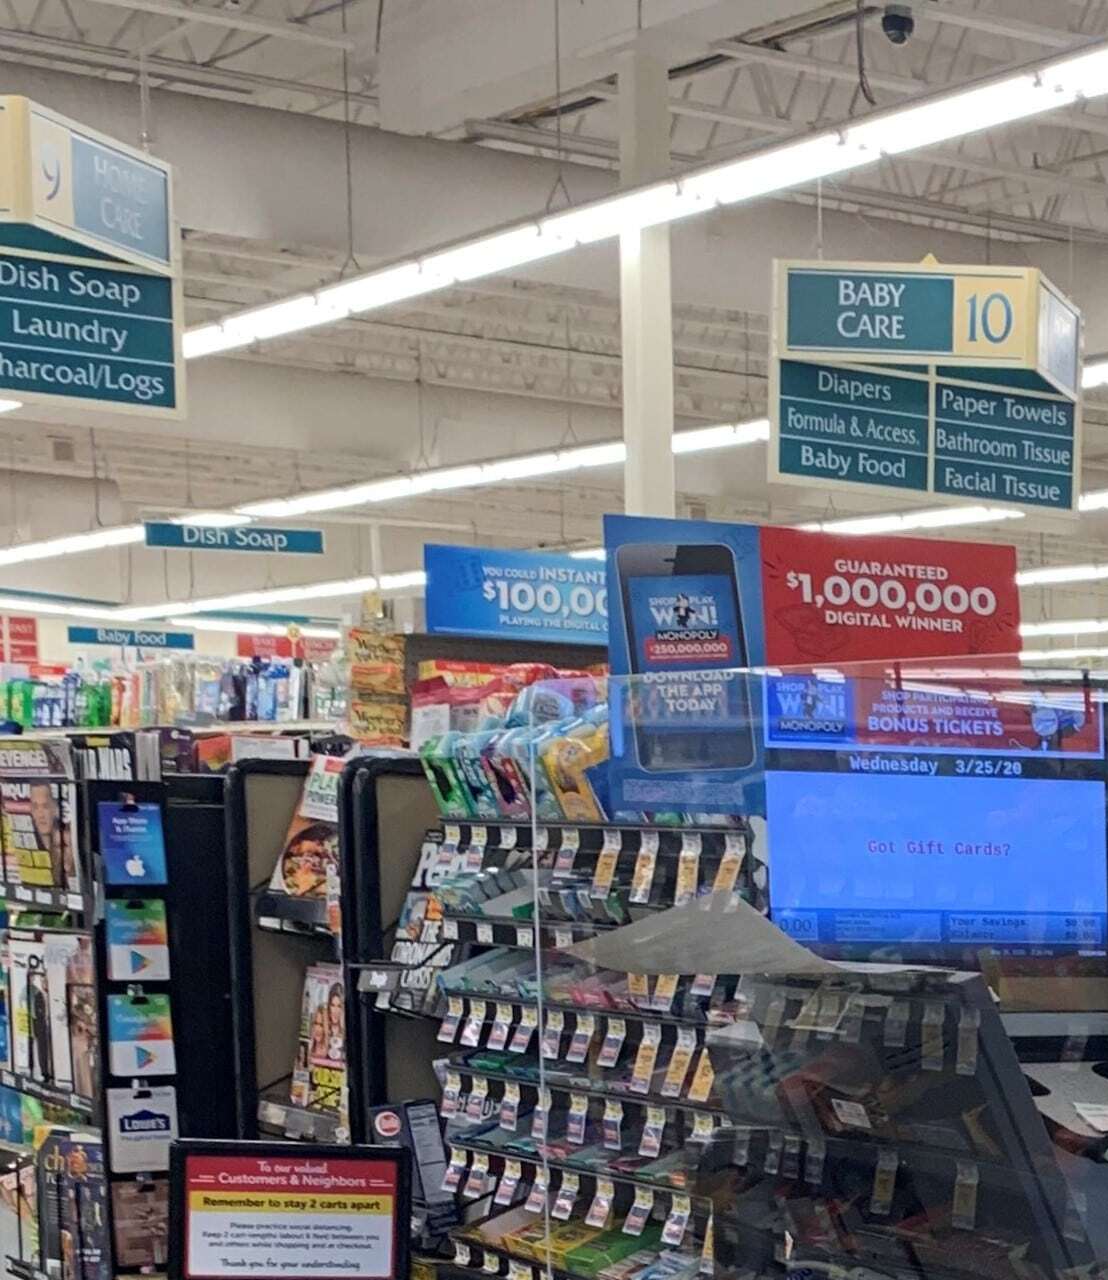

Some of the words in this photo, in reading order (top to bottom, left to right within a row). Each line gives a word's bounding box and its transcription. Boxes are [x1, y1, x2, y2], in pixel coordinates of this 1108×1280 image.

[0, 262, 59, 293] Dish
[68, 271, 141, 308] Soap
[838, 279, 906, 308] BABY
[836, 312, 906, 340] CARE
[966, 292, 1013, 344] 10
[12, 309, 128, 352] Laundry
[0, 354, 165, 401] harcoal/Logs
[818, 371, 892, 402] Diapers
[941, 389, 997, 418] Paper
[1003, 398, 1068, 427] Towels
[787, 407, 846, 437] Formula
[849, 417, 863, 438] &
[866, 420, 920, 446] Access.
[936, 429, 1017, 459] Bathroom
[1022, 441, 1071, 466] Tissue
[801, 445, 852, 475] Baby
[858, 453, 906, 478] Food
[944, 467, 996, 492] Facial
[1003, 475, 1061, 501] Tissue
[183, 525, 229, 546] Dish
[235, 526, 288, 552] Soap
[482, 566, 503, 577] YOU
[505, 569, 538, 580] COULD
[539, 566, 607, 583] INSTANT
[834, 559, 948, 581] GUARANTEED
[786, 571, 997, 617] $1,000,000
[500, 616, 540, 627] PLAYING
[543, 618, 561, 628] THE
[563, 619, 601, 631] DIGITAL
[825, 610, 892, 629] DIGITAL
[895, 615, 964, 633] WINNER
[97, 628, 130, 646] Baby
[134, 630, 167, 646] Food
[656, 630, 718, 641] MONOPOLY
[643, 671, 735, 683] DOWNLOAD
[657, 684, 689, 697] THE
[692, 683, 723, 697] APP
[665, 699, 716, 713] TODAY
[871, 704, 929, 716] PRODUCTS
[931, 706, 953, 716] AND
[954, 707, 999, 718] RECEIVE
[780, 720, 844, 733] MONOPOLY
[868, 717, 929, 733] BONUS
[935, 719, 1004, 736] TICKETS
[850, 756, 938, 776] Wednesday
[955, 759, 1022, 776] 3/25/20
[868, 840, 896, 854] Got
[907, 841, 945, 855] Gift
[954, 842, 1011, 857] Cards?
[257, 1160, 271, 1173] To
[274, 1164, 292, 1173] our
[294, 1162, 328, 1174] valued
[218, 1172, 287, 1185] Customers
[289, 1175, 300, 1185] &
[302, 1175, 367, 1188] Neighbors
[203, 1197, 265, 1208] Remember
[268, 1199, 281, 1208] to
[284, 1199, 307, 1210] stay
[309, 1200, 317, 1209] 2
[320, 1201, 348, 1210] carts
[350, 1201, 380, 1212] apart
[220, 1258, 247, 1268] Thank
[249, 1260, 264, 1270] you
[280, 1260, 299, 1271] your
